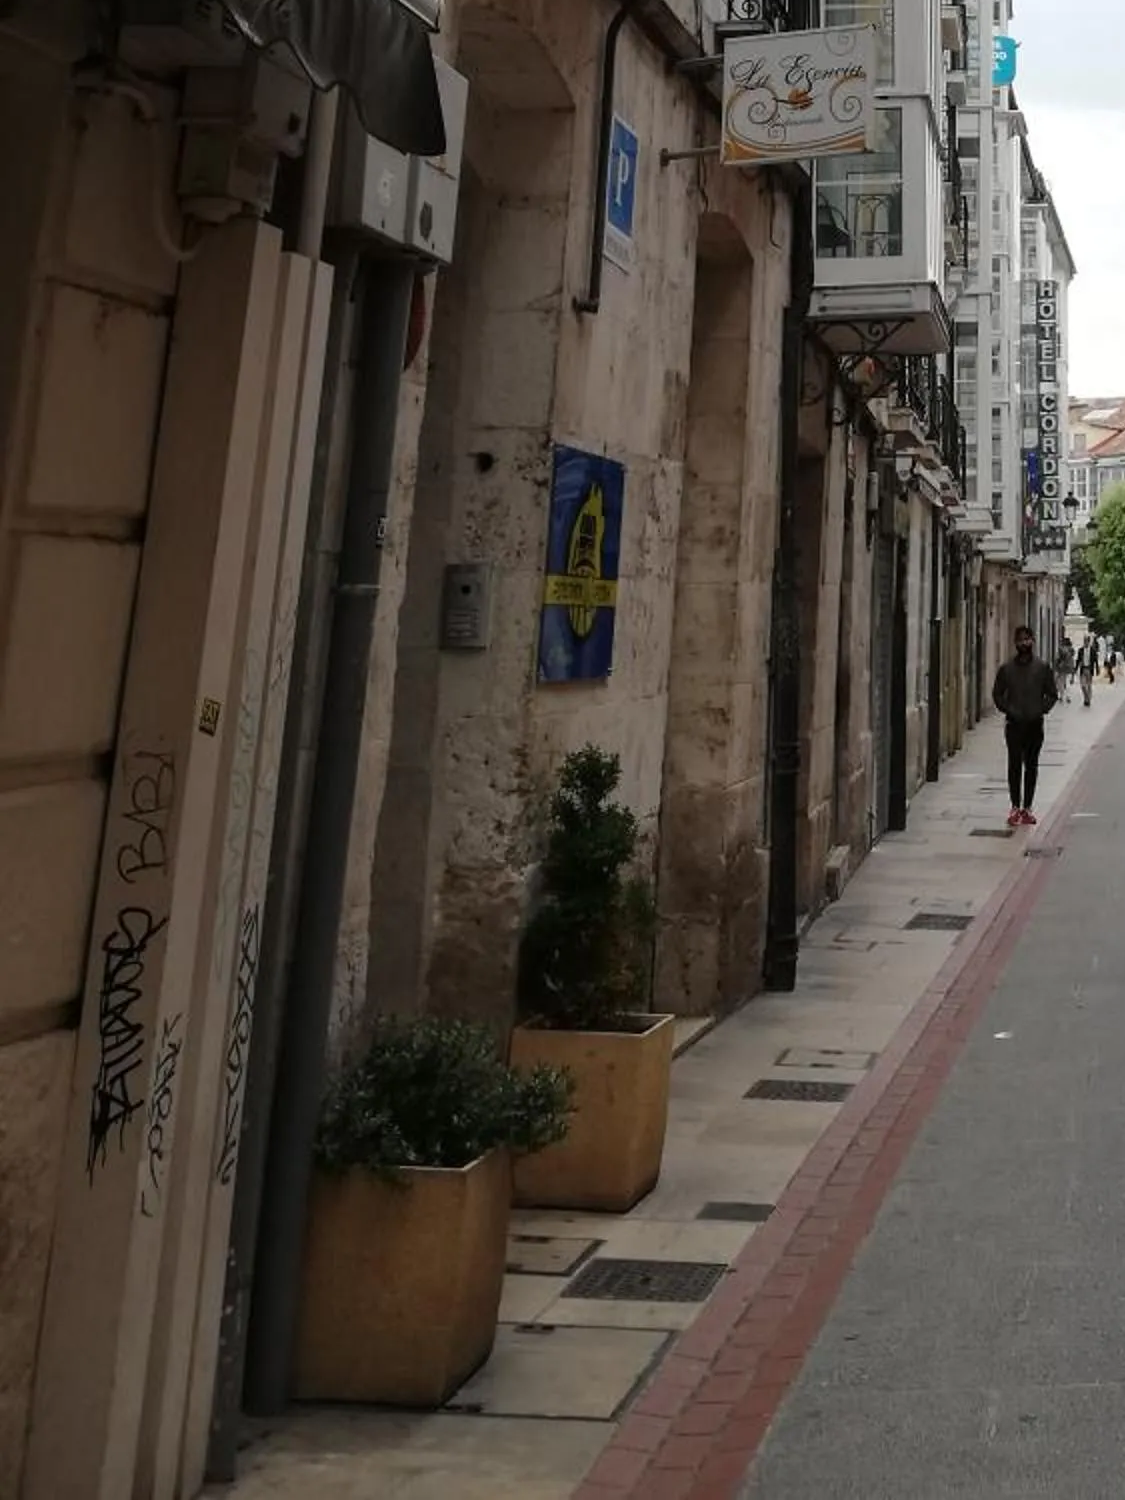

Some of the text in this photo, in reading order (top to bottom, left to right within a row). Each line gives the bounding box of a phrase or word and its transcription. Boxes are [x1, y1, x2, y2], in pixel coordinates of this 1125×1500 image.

[614, 148, 629, 207] P
[1040, 281, 1057, 519] HOTEL CORDON
